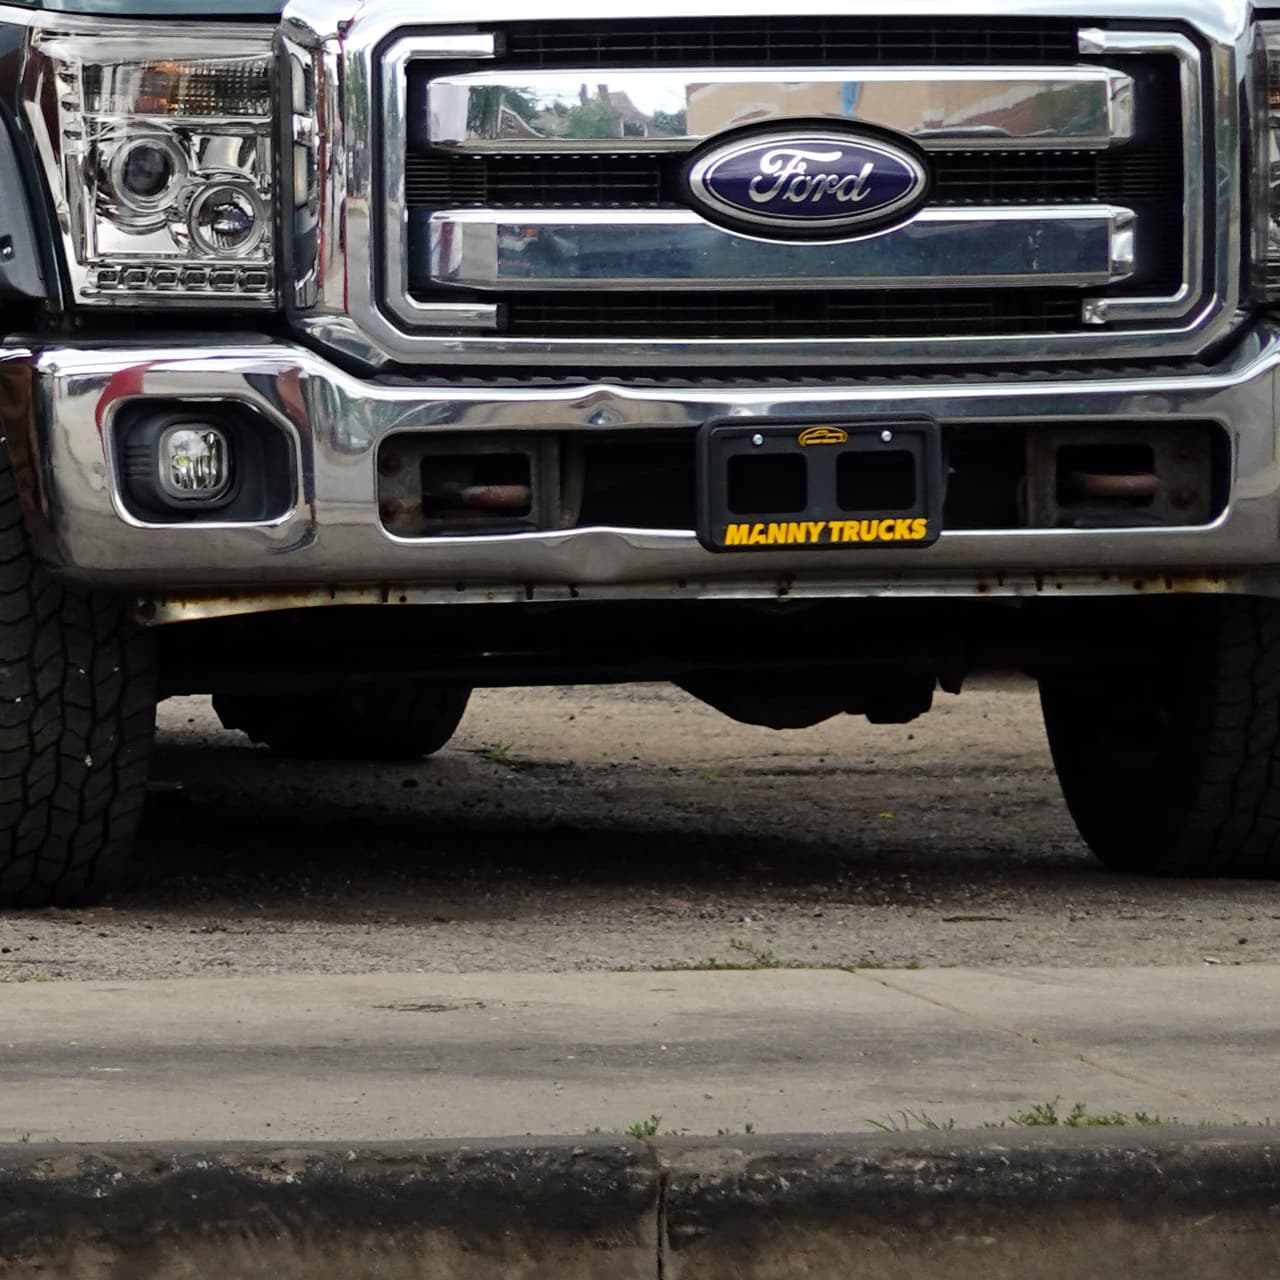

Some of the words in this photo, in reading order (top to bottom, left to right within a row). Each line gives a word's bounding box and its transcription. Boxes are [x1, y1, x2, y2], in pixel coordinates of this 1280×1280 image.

[748, 148, 875, 204] Ford
[724, 521, 826, 545] MANNY
[829, 518, 927, 542] TRUCKS
